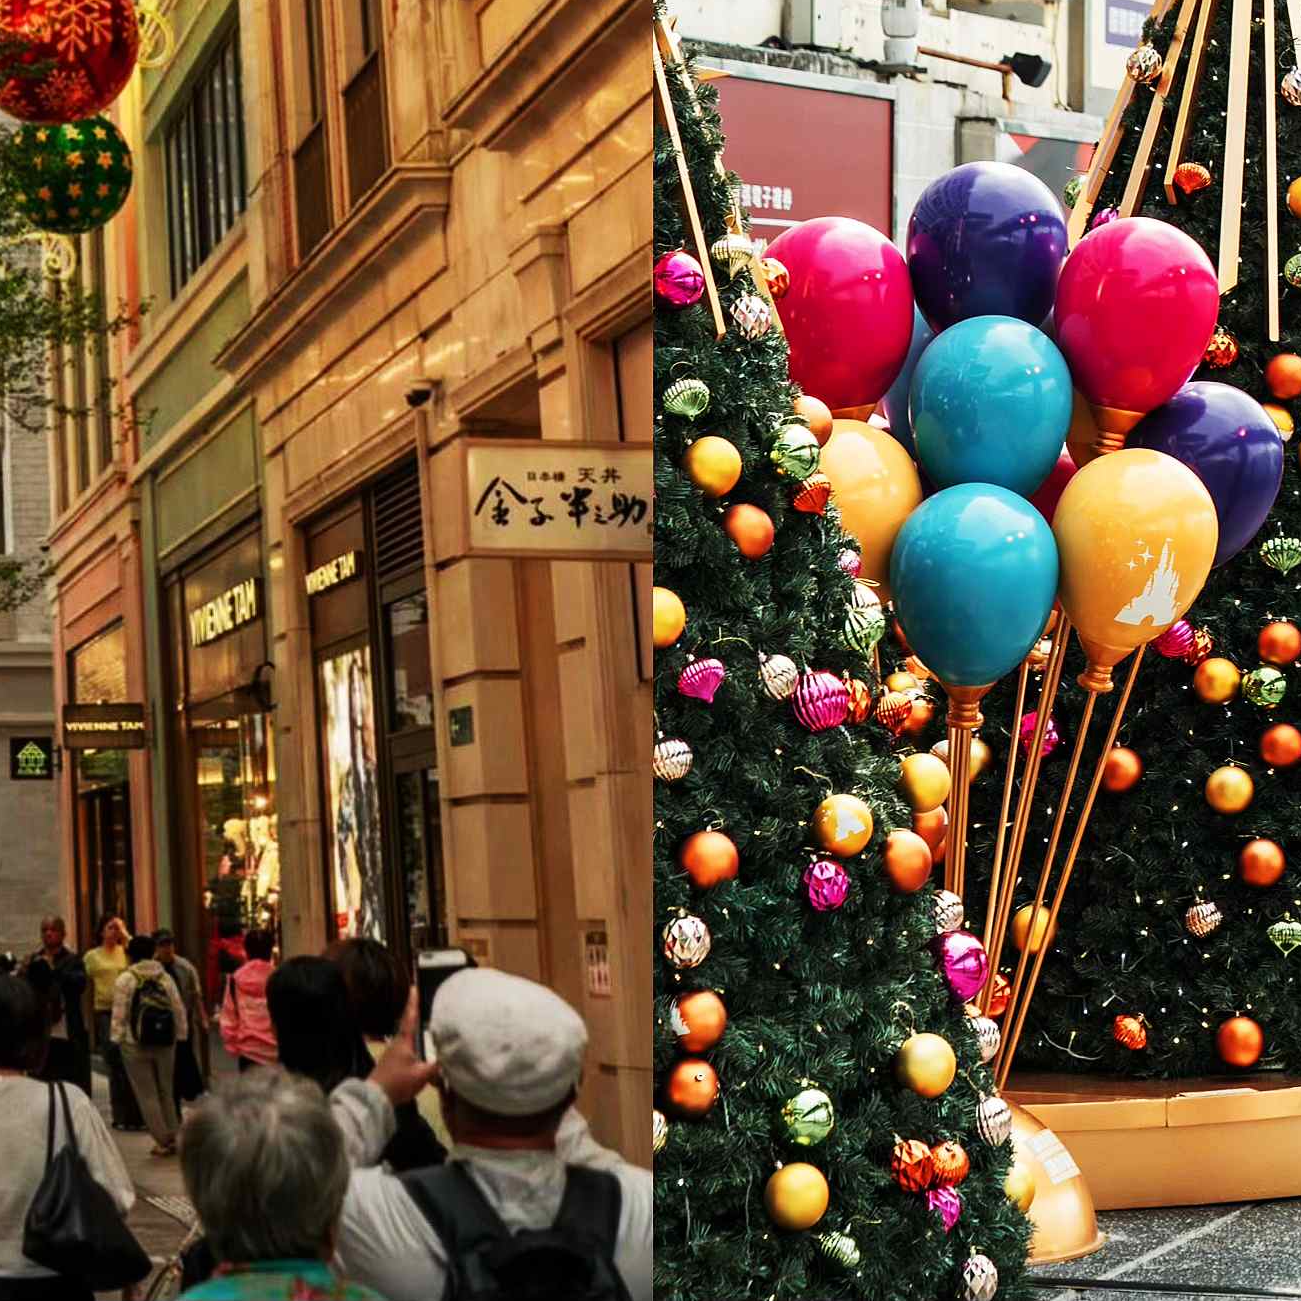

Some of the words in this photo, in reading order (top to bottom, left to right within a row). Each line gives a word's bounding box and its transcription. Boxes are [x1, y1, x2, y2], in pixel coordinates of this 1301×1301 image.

[305, 560, 339, 595] VIVIENNE
[338, 550, 356, 580] TAM
[190, 590, 234, 647] VIVIENNE
[233, 577, 257, 625] TAM
[66, 721, 118, 731] VIVIENNE
[121, 721, 144, 730] TAM
